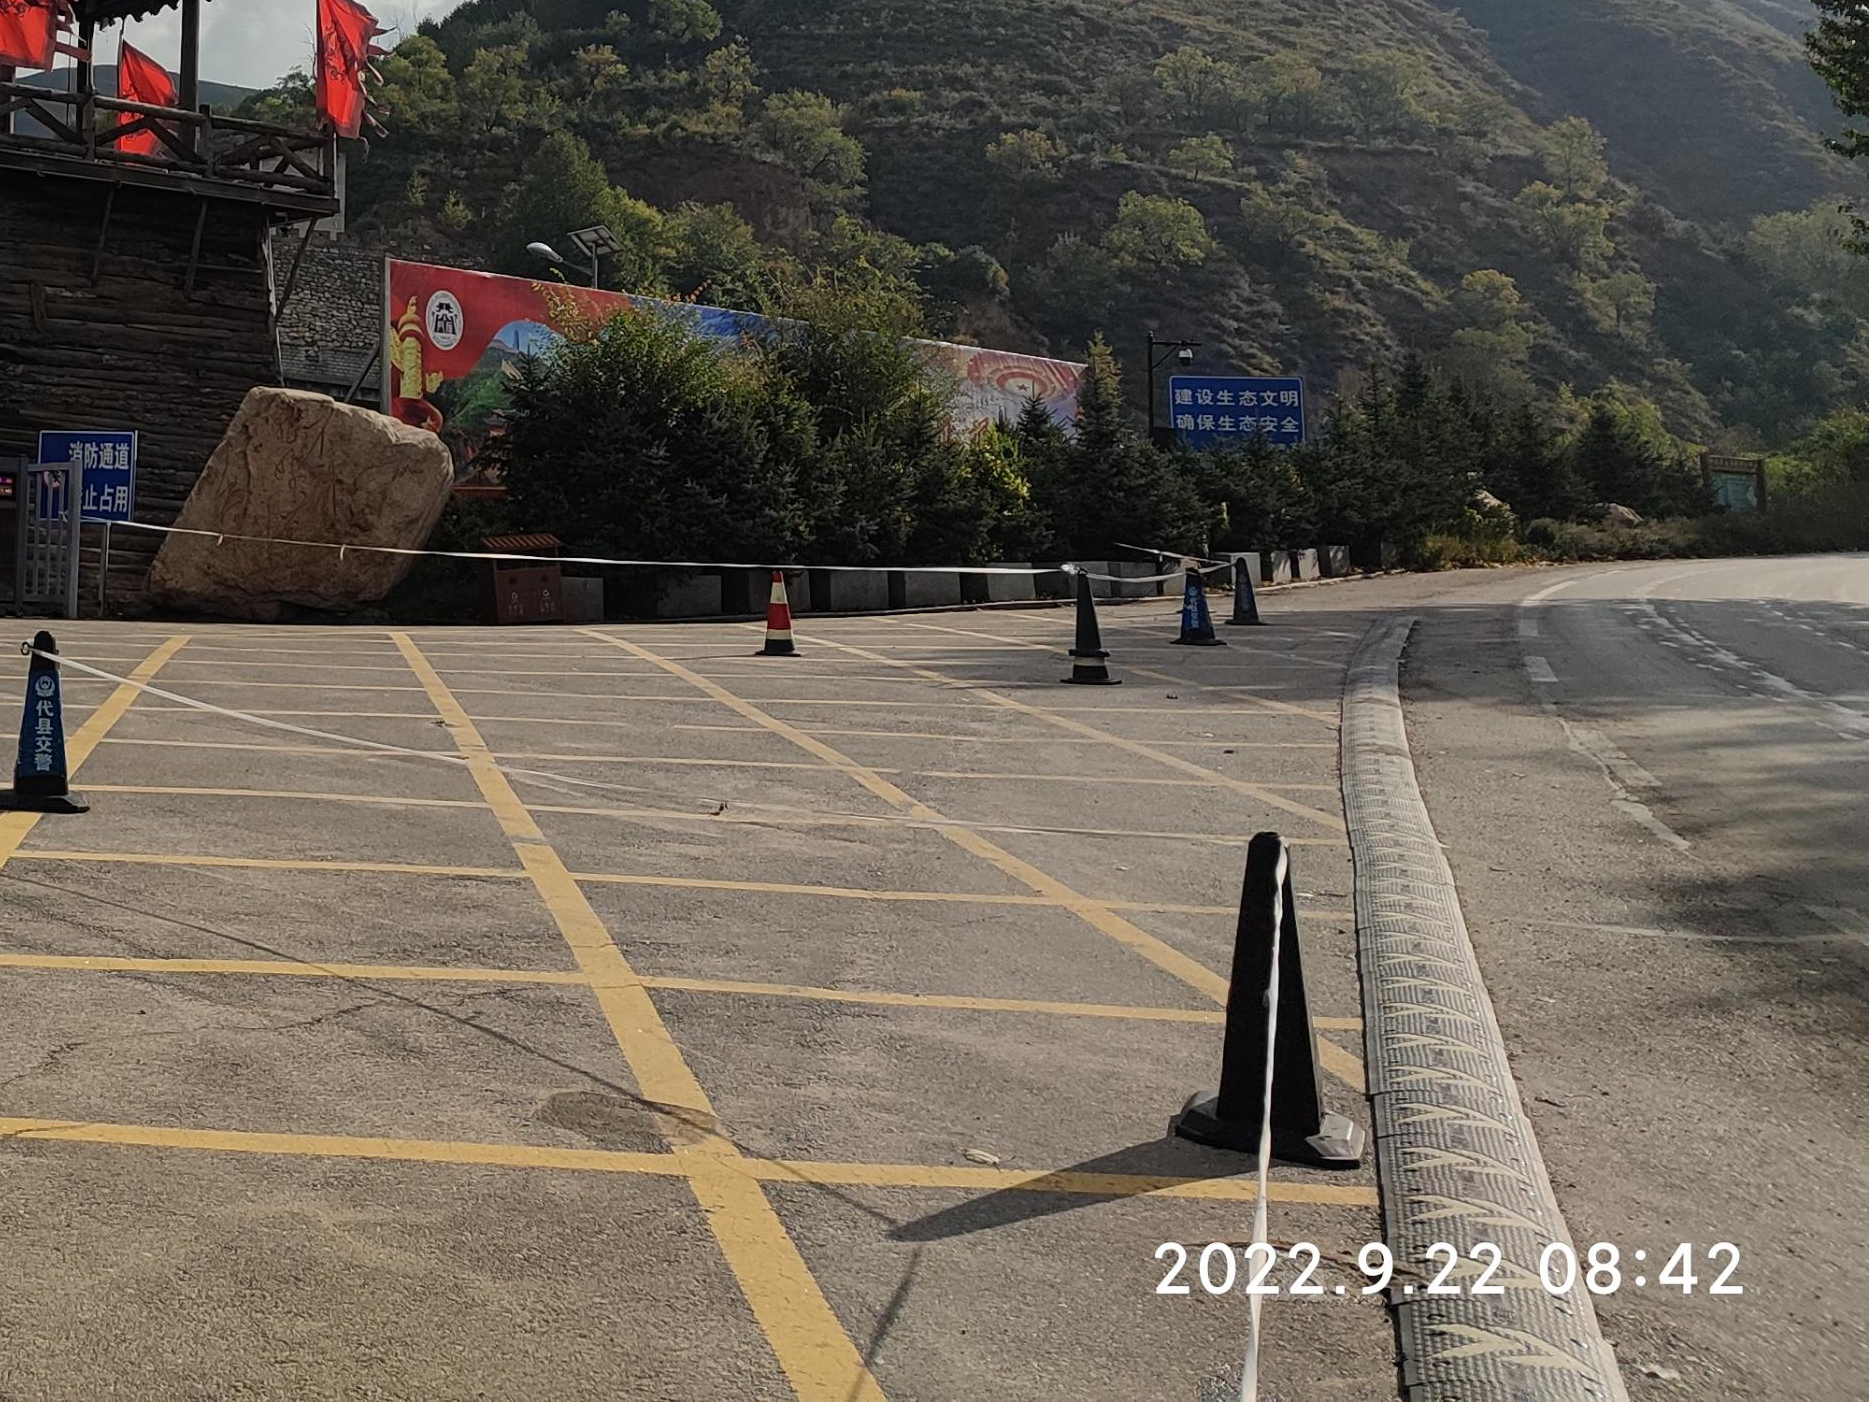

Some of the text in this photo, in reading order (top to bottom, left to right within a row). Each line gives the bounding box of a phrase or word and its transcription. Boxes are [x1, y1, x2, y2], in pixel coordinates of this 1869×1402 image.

[1173, 388, 1300, 408] 建设生态文明
[1175, 413, 1300, 433] 确保生态安全
[68, 440, 131, 471] 消防通道
[80, 482, 129, 514] 止占用
[34, 699, 54, 772] 代县交警
